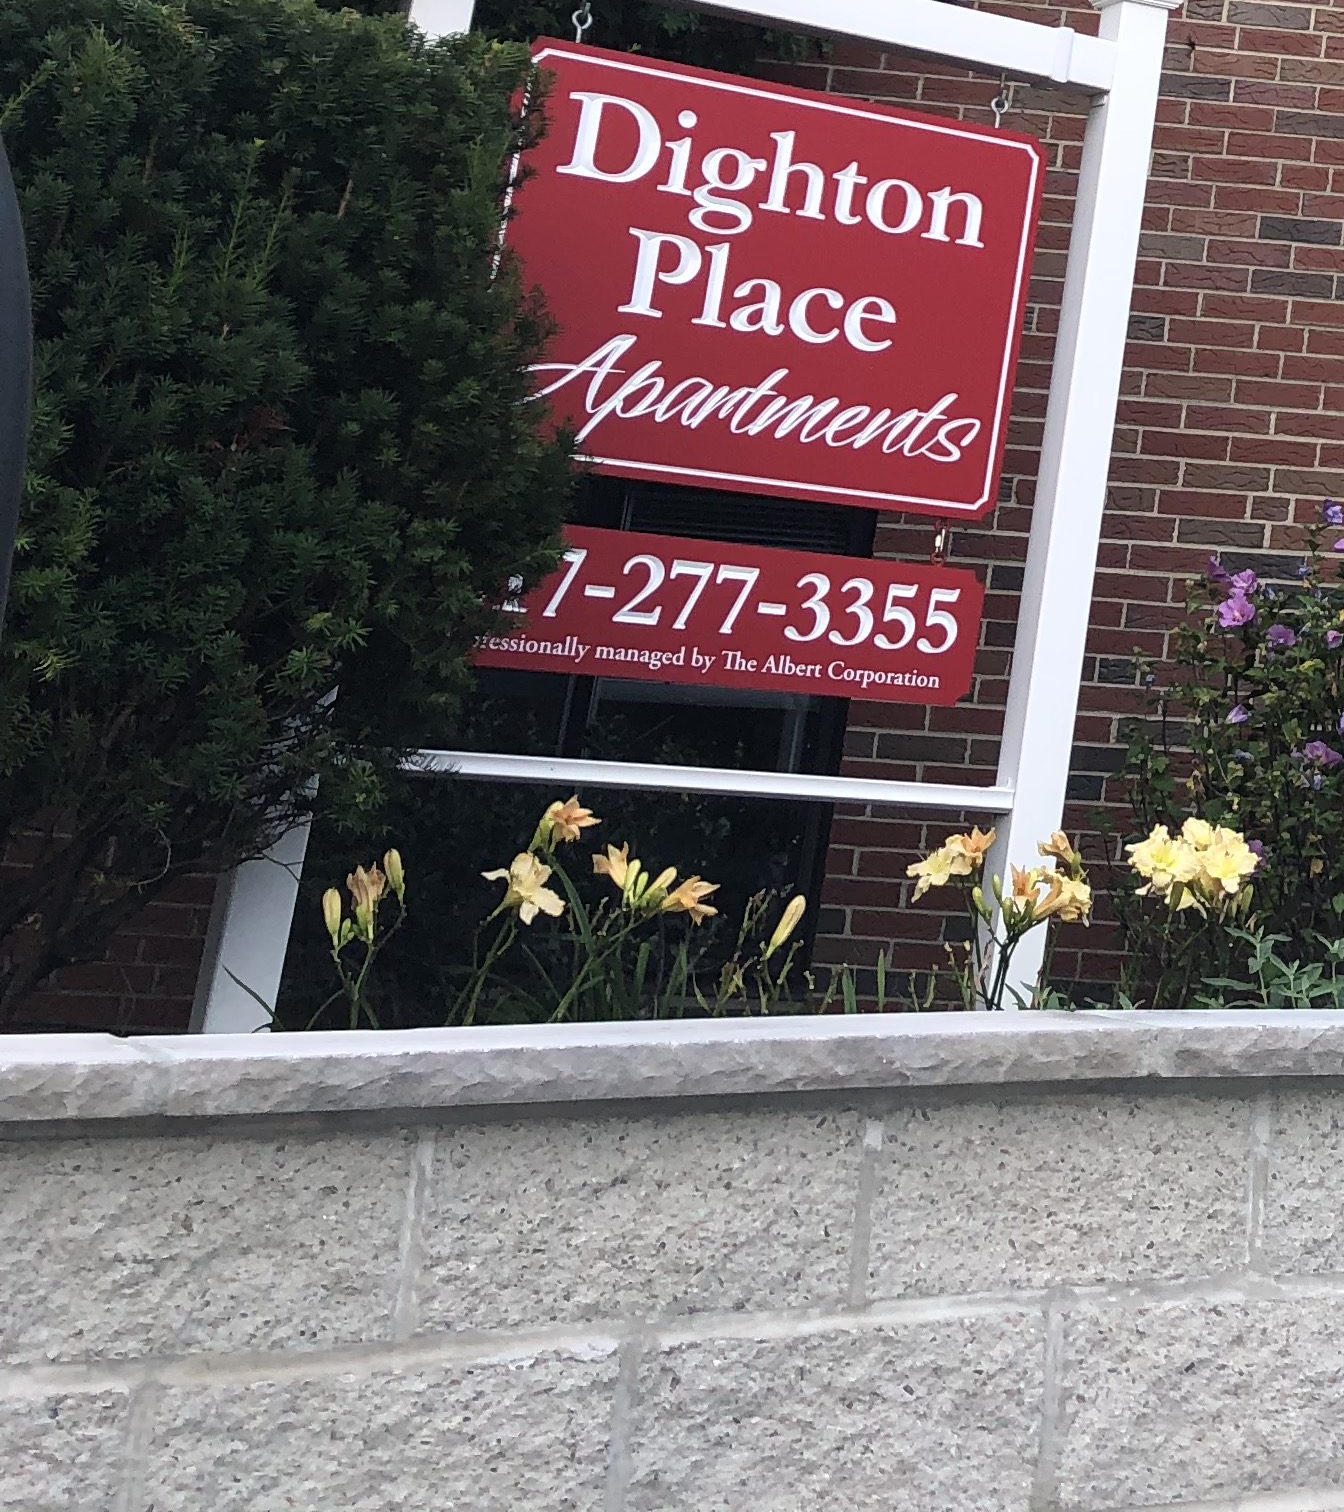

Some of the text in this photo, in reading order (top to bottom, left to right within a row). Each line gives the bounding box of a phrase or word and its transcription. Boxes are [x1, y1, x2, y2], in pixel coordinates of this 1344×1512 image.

[556, 91, 985, 249] Dighton
[617, 226, 898, 352] Place
[521, 334, 981, 463] Apartments
[594, 646, 686, 670] managed
[691, 646, 717, 674] by
[721, 650, 758, 672] The
[761, 655, 823, 678] Albert
[828, 661, 940, 689] Corporation
